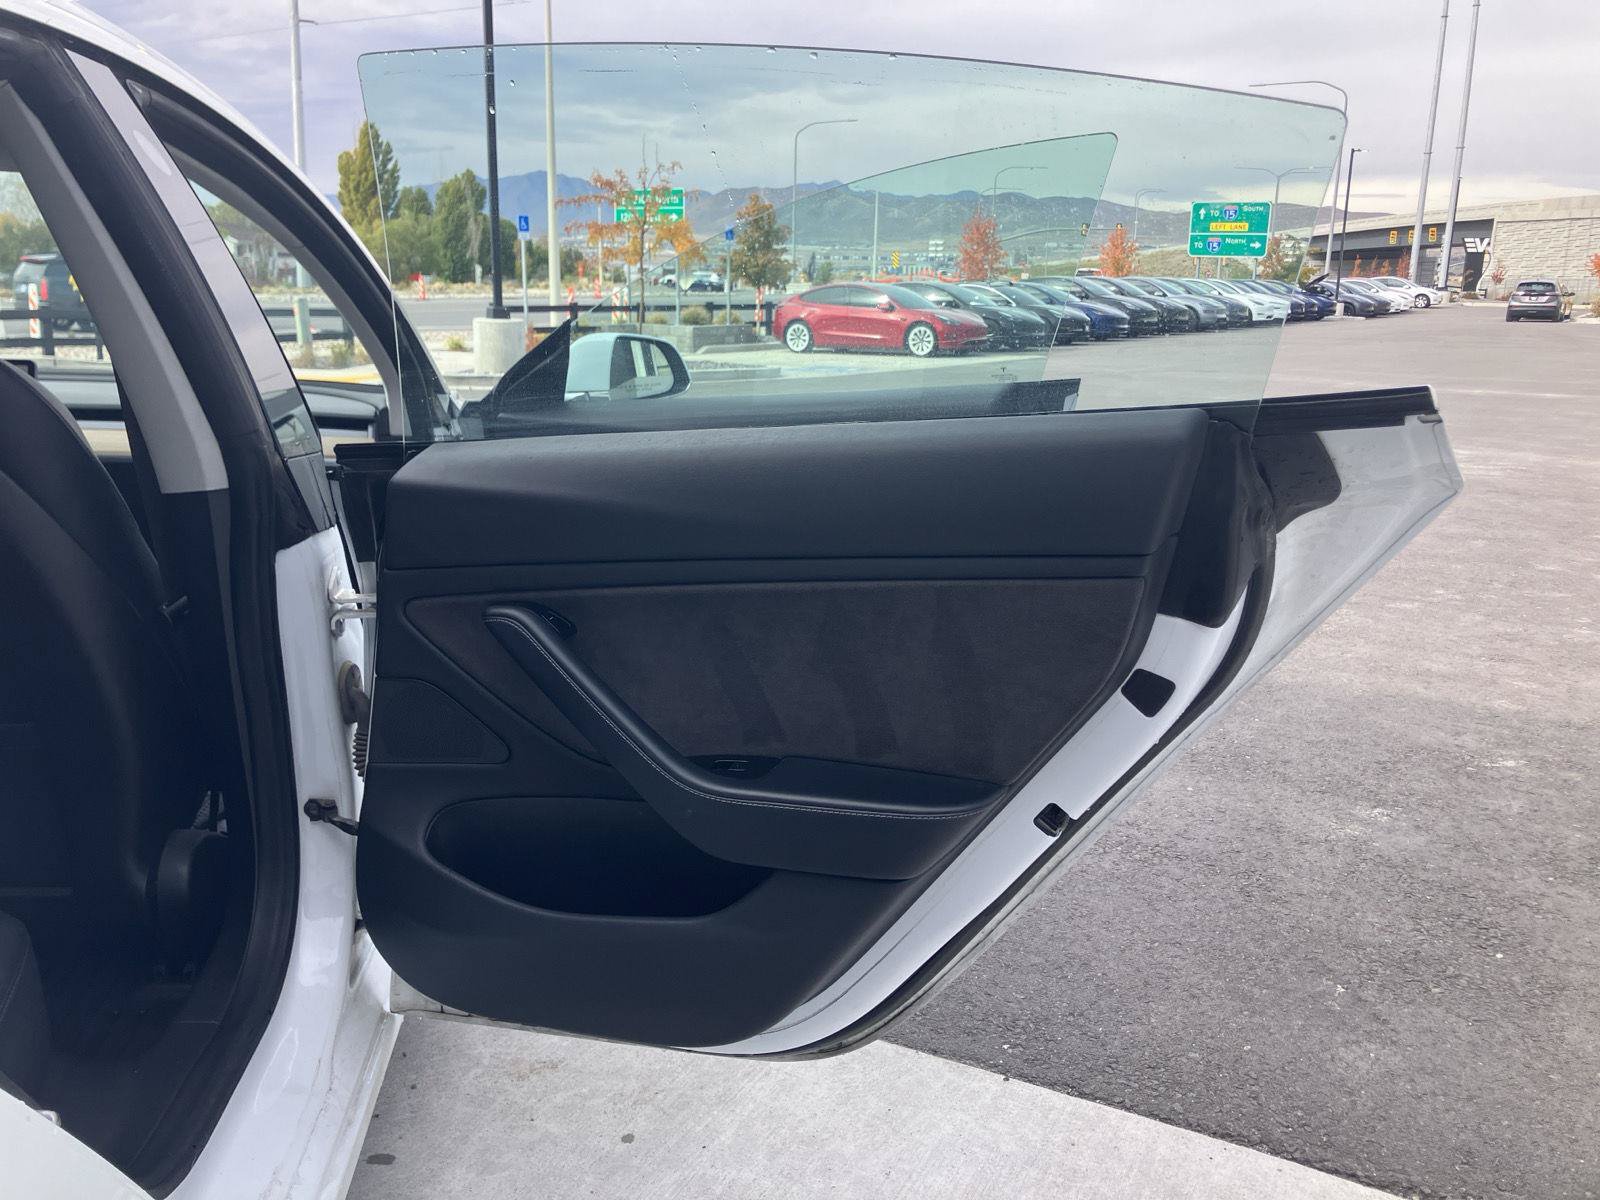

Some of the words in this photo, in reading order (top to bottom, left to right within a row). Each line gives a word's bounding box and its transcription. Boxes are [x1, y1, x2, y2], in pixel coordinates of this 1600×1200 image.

[1210, 209, 1220, 217] TO
[1225, 210, 1236, 219] 15
[1194, 241, 1203, 249] TO
[1209, 242, 1218, 251] 15
[1464, 237, 1490, 253] EV
